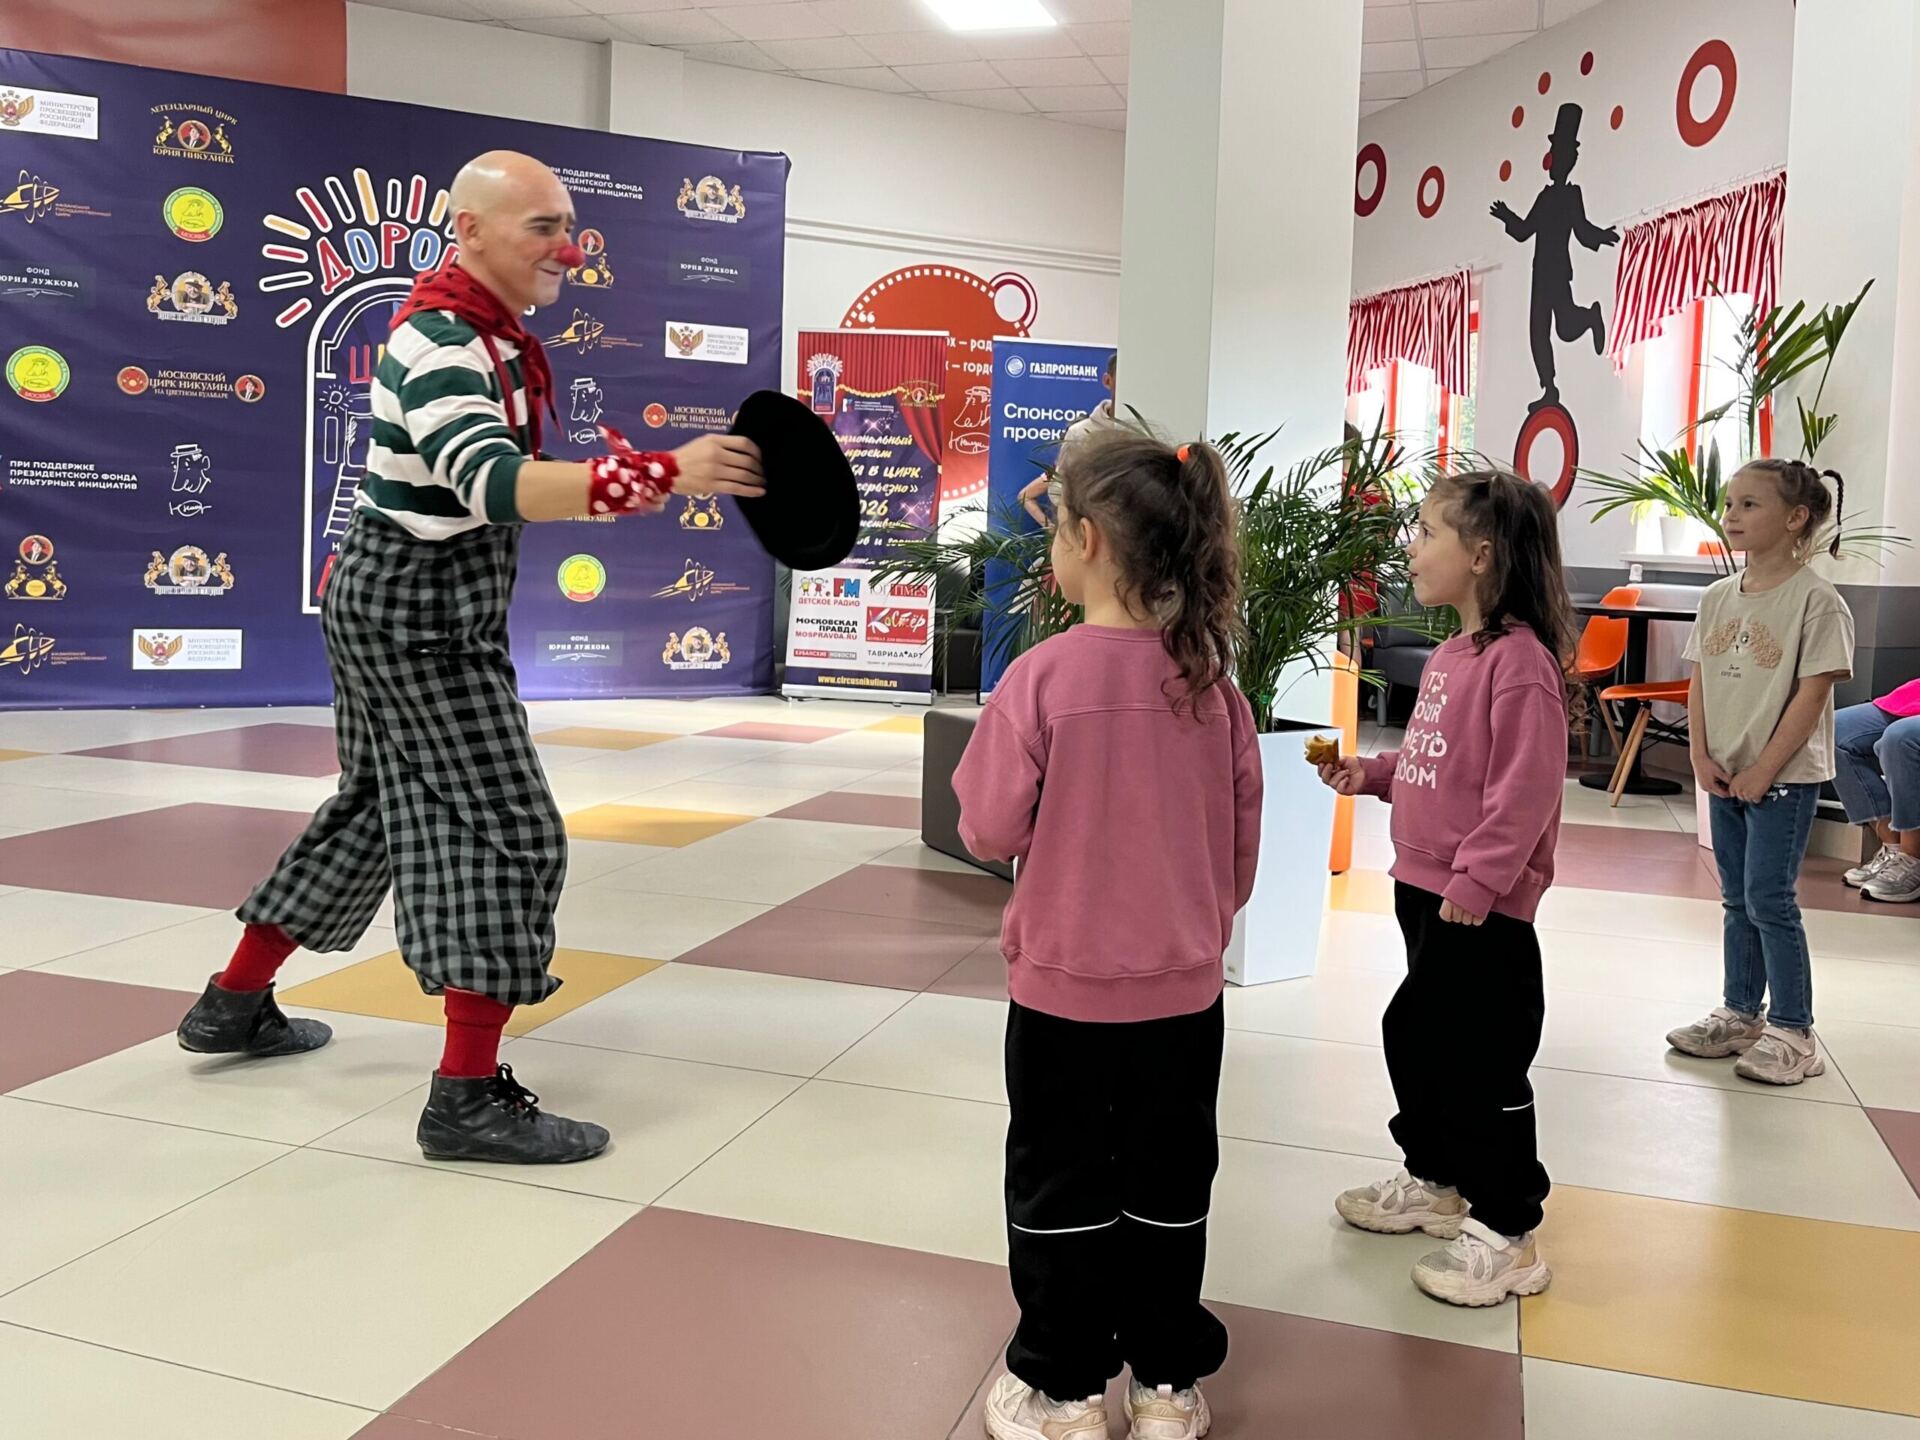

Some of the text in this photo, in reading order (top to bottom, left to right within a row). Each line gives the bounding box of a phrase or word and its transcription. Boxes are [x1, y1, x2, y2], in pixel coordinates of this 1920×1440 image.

[215, 110, 238, 125] ЦИРК
[153, 147, 234, 163] ЮРИЯ НИКУЛИНА
[563, 168, 610, 180] ПОДДЕРЖКЕ
[560, 176, 643, 192] ЗИДЕНТСКОГО ФОНДА
[597, 189, 643, 200] ИНИЦИАТИВ
[26, 267, 50, 276] ФОНД
[31, 277, 79, 288] ЛУЖКОВА
[970, 338, 993, 353] рад
[1029, 361, 1099, 377] ГАЗПРОМБАНК
[158, 370, 226, 382] МОСКОВСКИЙ
[150, 378, 234, 392] ЦИРК НИКУЛИНА
[674, 406, 726, 417] МОСКОВСКИЙ
[690, 415, 731, 425] НИКУЛИНА
[832, 430, 913, 446] ациональный
[1003, 426, 1066, 443] проек
[10, 460, 95, 471] ПРИ ПОДДЕРЖКЕ
[10, 469, 138, 482] ПРЕЗИДЕНТСКОГО ФОНДА
[10, 478, 138, 490] КУЛЬТУРНЫХ ИНИЦИАТИВ
[860, 499, 889, 516] 026
[833, 577, 861, 599] FM
[798, 597, 861, 607] ДЕТСКОЕ РАДИО
[796, 617, 858, 627] МОСКОВСКАЯ
[795, 631, 858, 640] MOSPRAVDA.RU
[819, 625, 857, 634] ПРАВДА
[818, 676, 898, 688] www.circusnikulina.ru
[1414, 700, 1442, 724] OUR
